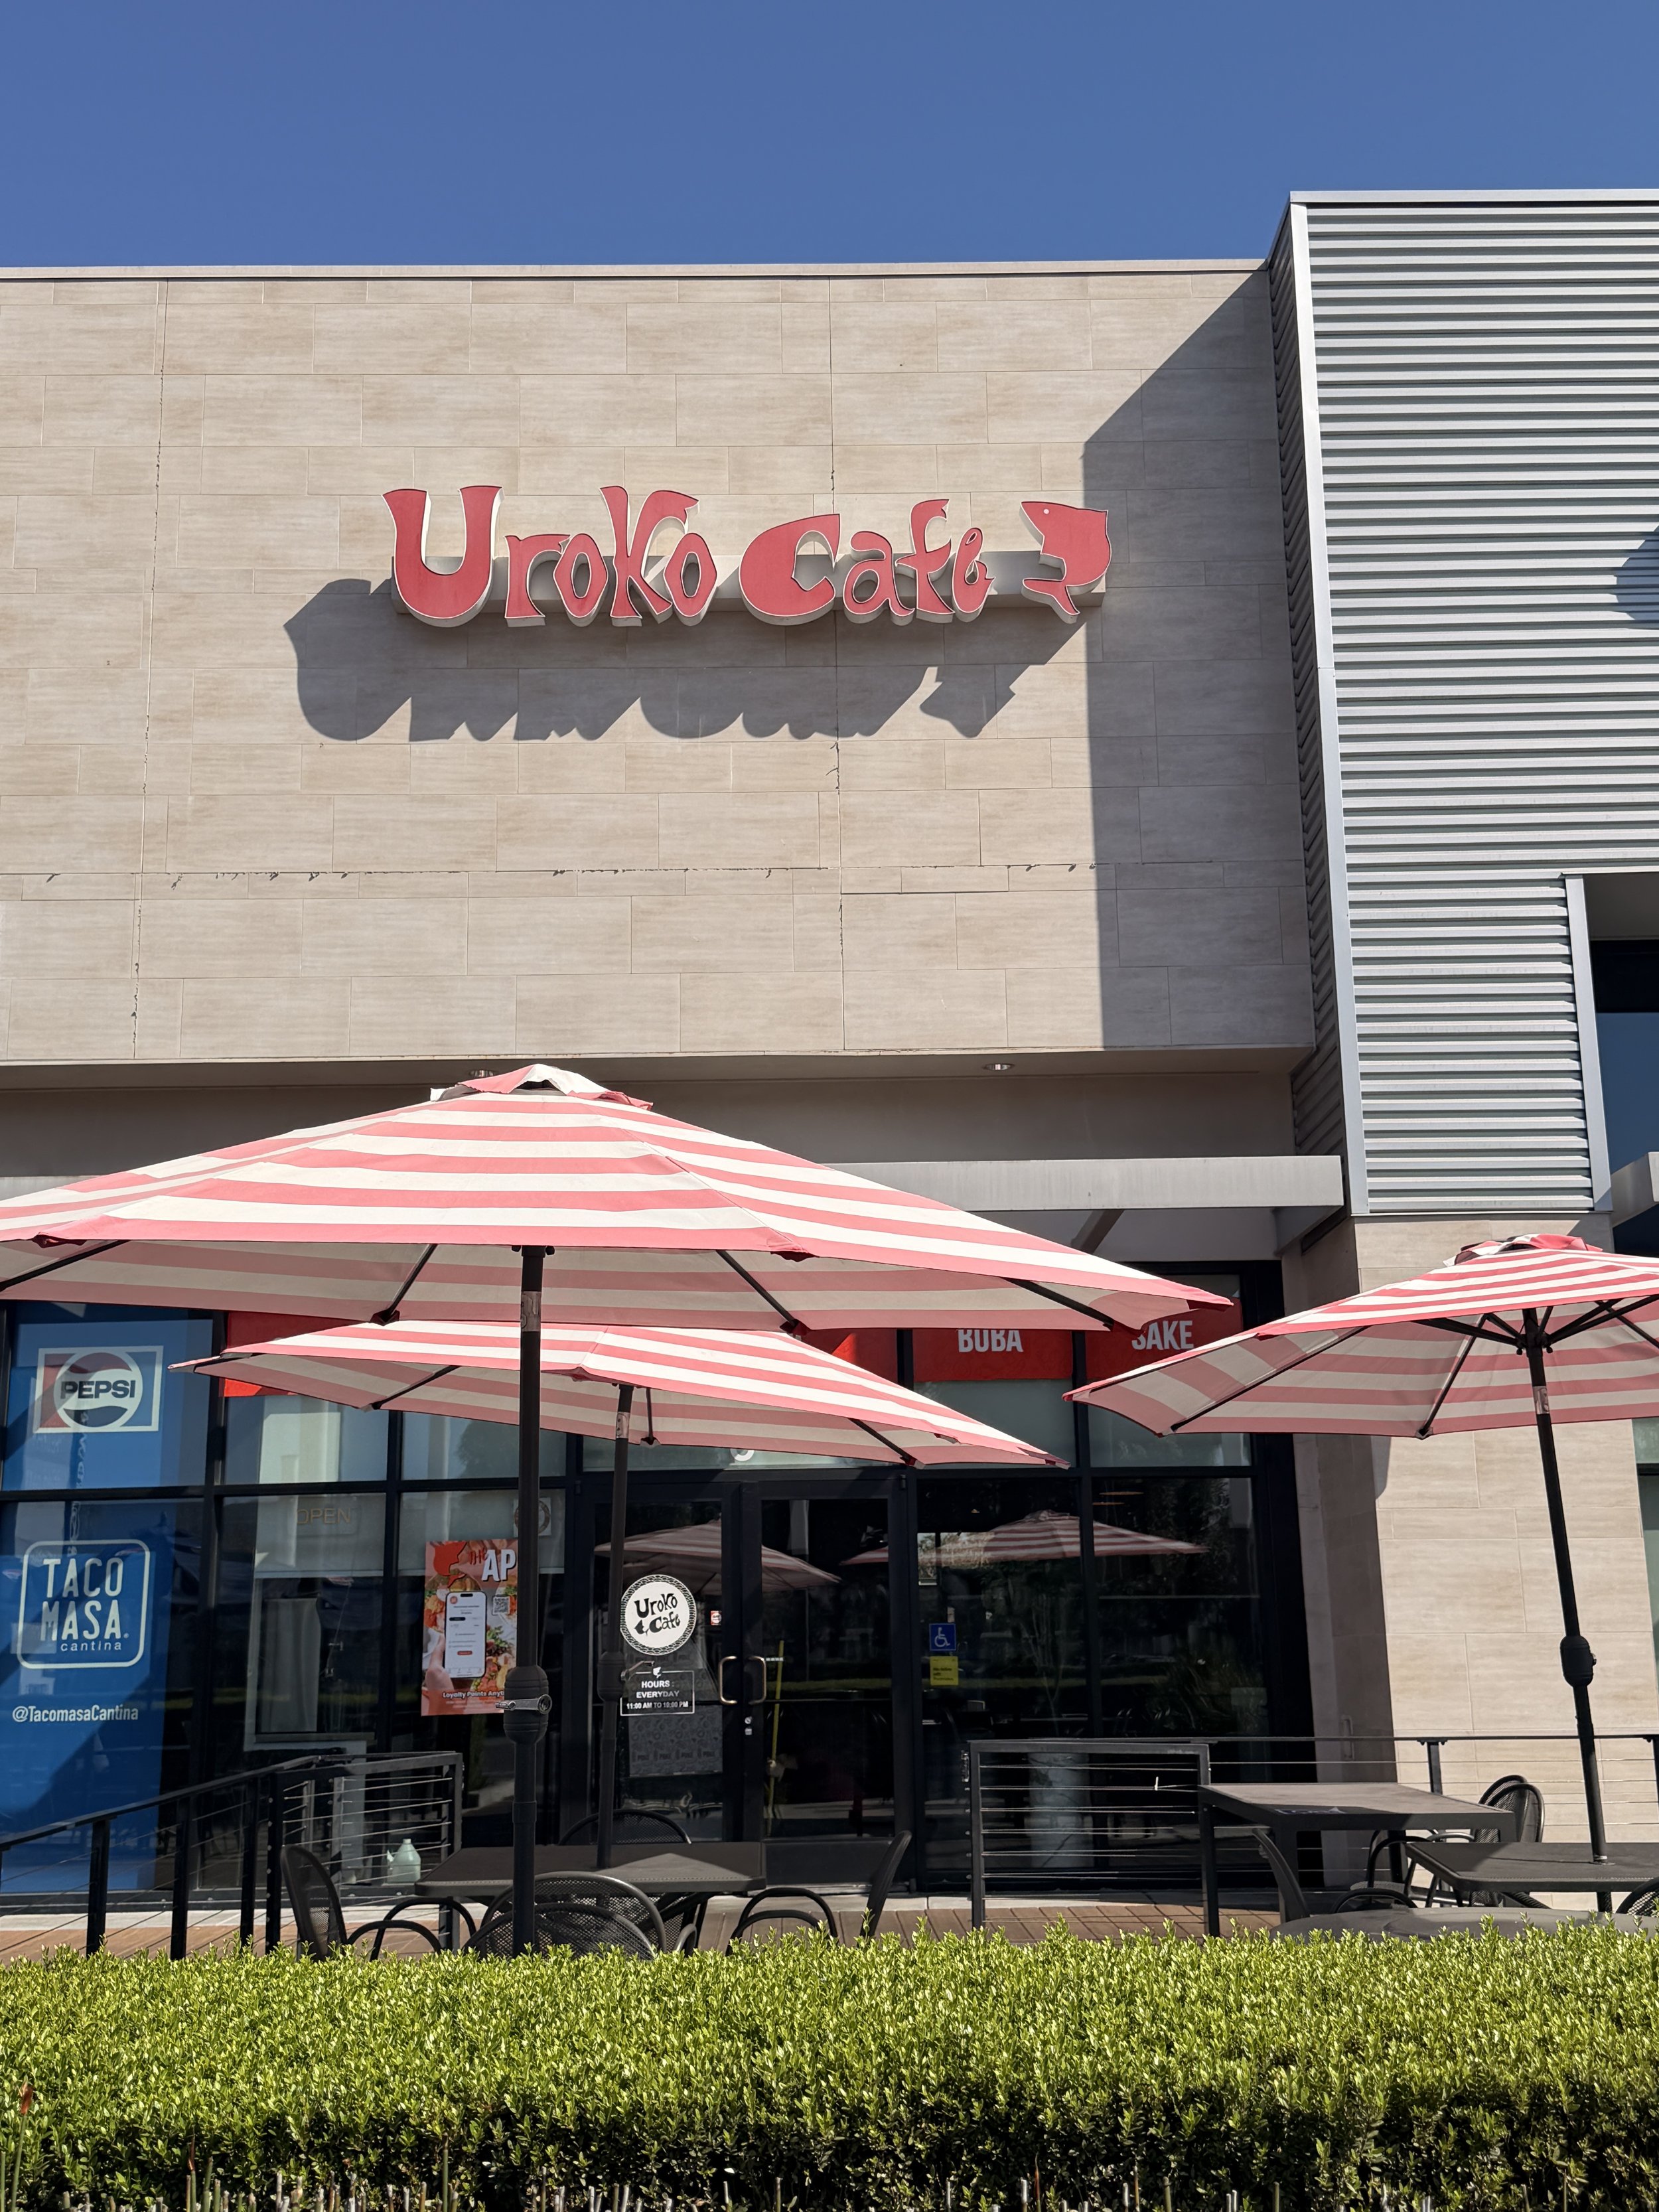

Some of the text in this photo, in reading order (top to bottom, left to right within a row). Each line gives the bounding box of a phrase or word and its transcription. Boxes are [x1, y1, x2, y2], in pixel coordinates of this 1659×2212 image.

[382, 485, 995, 623] Uroko Cafe
[60, 1380, 135, 1399] PEPSI
[297, 1507, 350, 1524] OPEN
[481, 1549, 517, 1582] AP
[43, 1558, 123, 1598] TACO
[634, 1593, 678, 1619] Uroko
[649, 1611, 681, 1633] Cafe
[60, 1640, 122, 1651] cantina
[12, 1704, 139, 1722] @TacomasaCantina
